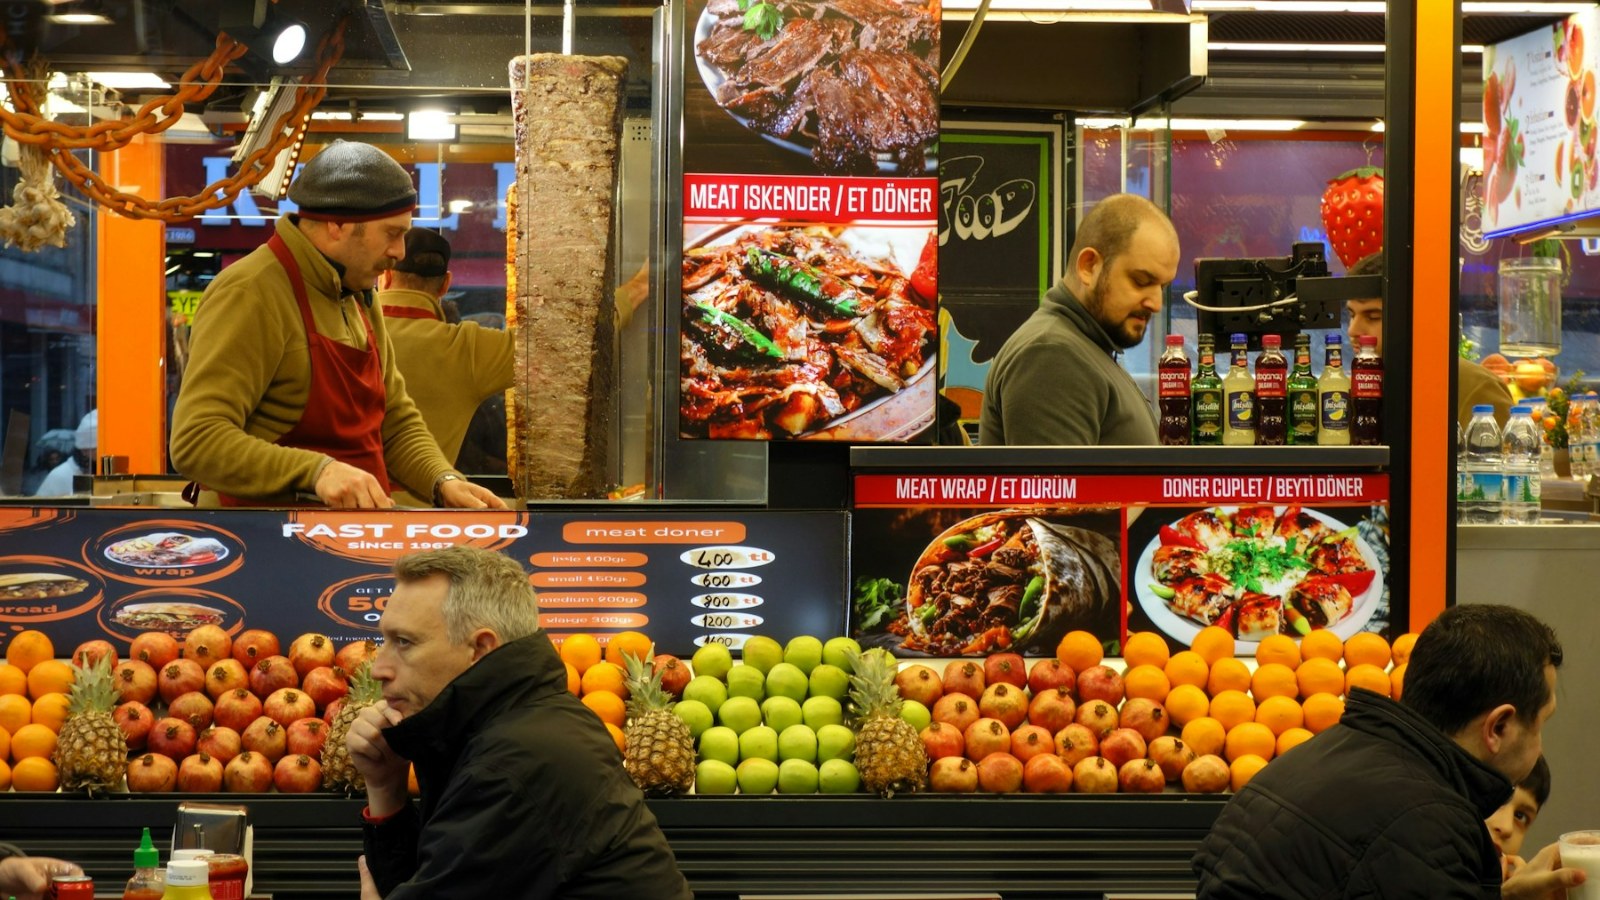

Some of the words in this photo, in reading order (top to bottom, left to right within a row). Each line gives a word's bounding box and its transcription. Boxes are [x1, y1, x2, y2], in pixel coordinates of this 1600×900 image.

[690, 183, 739, 210] MEAT
[743, 184, 831, 212] ISKENDER
[834, 184, 843, 217] /
[848, 186, 867, 213] ET
[872, 182, 932, 213] DÖNER
[896, 477, 938, 499] MEAT
[941, 477, 987, 499] WRAP
[989, 476, 998, 502] /
[1001, 478, 1018, 499] ET
[1021, 474, 1077, 499] DÜRÜM
[1163, 478, 1209, 498] DONER
[1212, 478, 1263, 498] CUPLET
[1266, 476, 1273, 501] /
[1276, 474, 1314, 497] BEYTİ
[1317, 474, 1363, 497] DÖNER
[282, 523, 393, 538] FAST
[406, 523, 529, 539] FOOD
[586, 527, 647, 537] meat
[653, 527, 725, 537] doner
[410, 541, 455, 550] 1967
[697, 550, 733, 567] 400
[134, 567, 195, 577] wrap
[547, 575, 582, 583] small
[702, 573, 731, 588] 600
[702, 614, 732, 628] 1200
